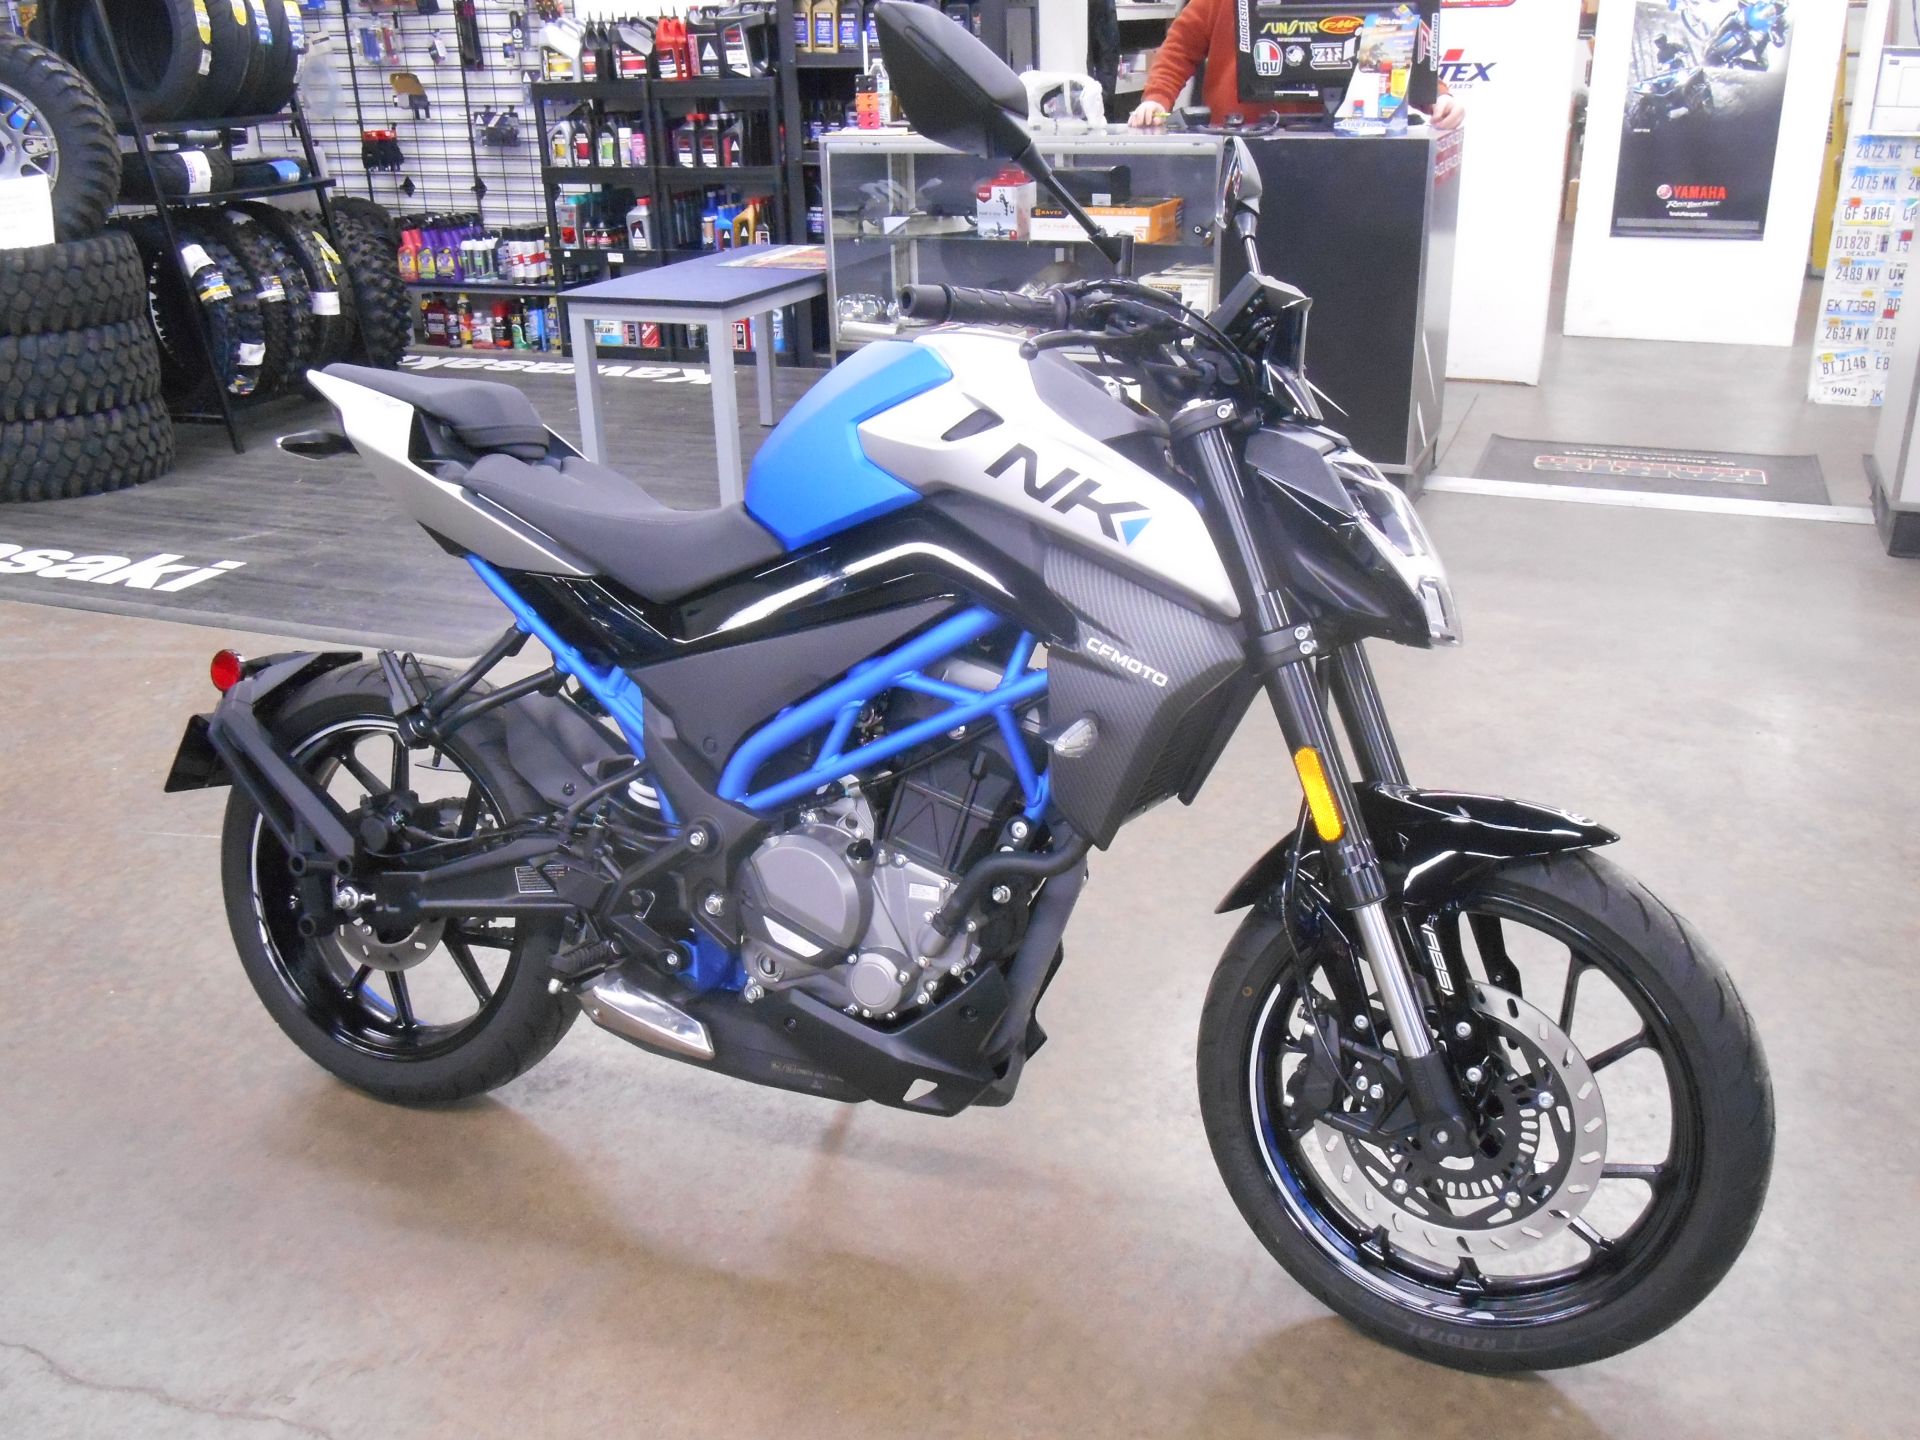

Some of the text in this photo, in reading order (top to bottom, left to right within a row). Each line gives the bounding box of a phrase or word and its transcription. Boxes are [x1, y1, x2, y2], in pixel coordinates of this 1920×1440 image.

[1260, 20, 1319, 35] SUNSTAR
[1850, 175, 1880, 190] 2075
[1673, 185, 1727, 200] YAMAHA
[1844, 206, 1891, 220] GF 5064
[1835, 235, 1871, 250] D1828
[1835, 267, 1863, 281] 2489
[1826, 299, 1877, 314] EK 7358
[1825, 327, 1852, 341] 2634
[1840, 356, 1867, 373] 7146
[1831, 386, 1858, 397] 9902
[984, 443, 1150, 542] NK
[1086, 637, 1168, 688] CFMOTO
[1422, 929, 1454, 992] ABS
